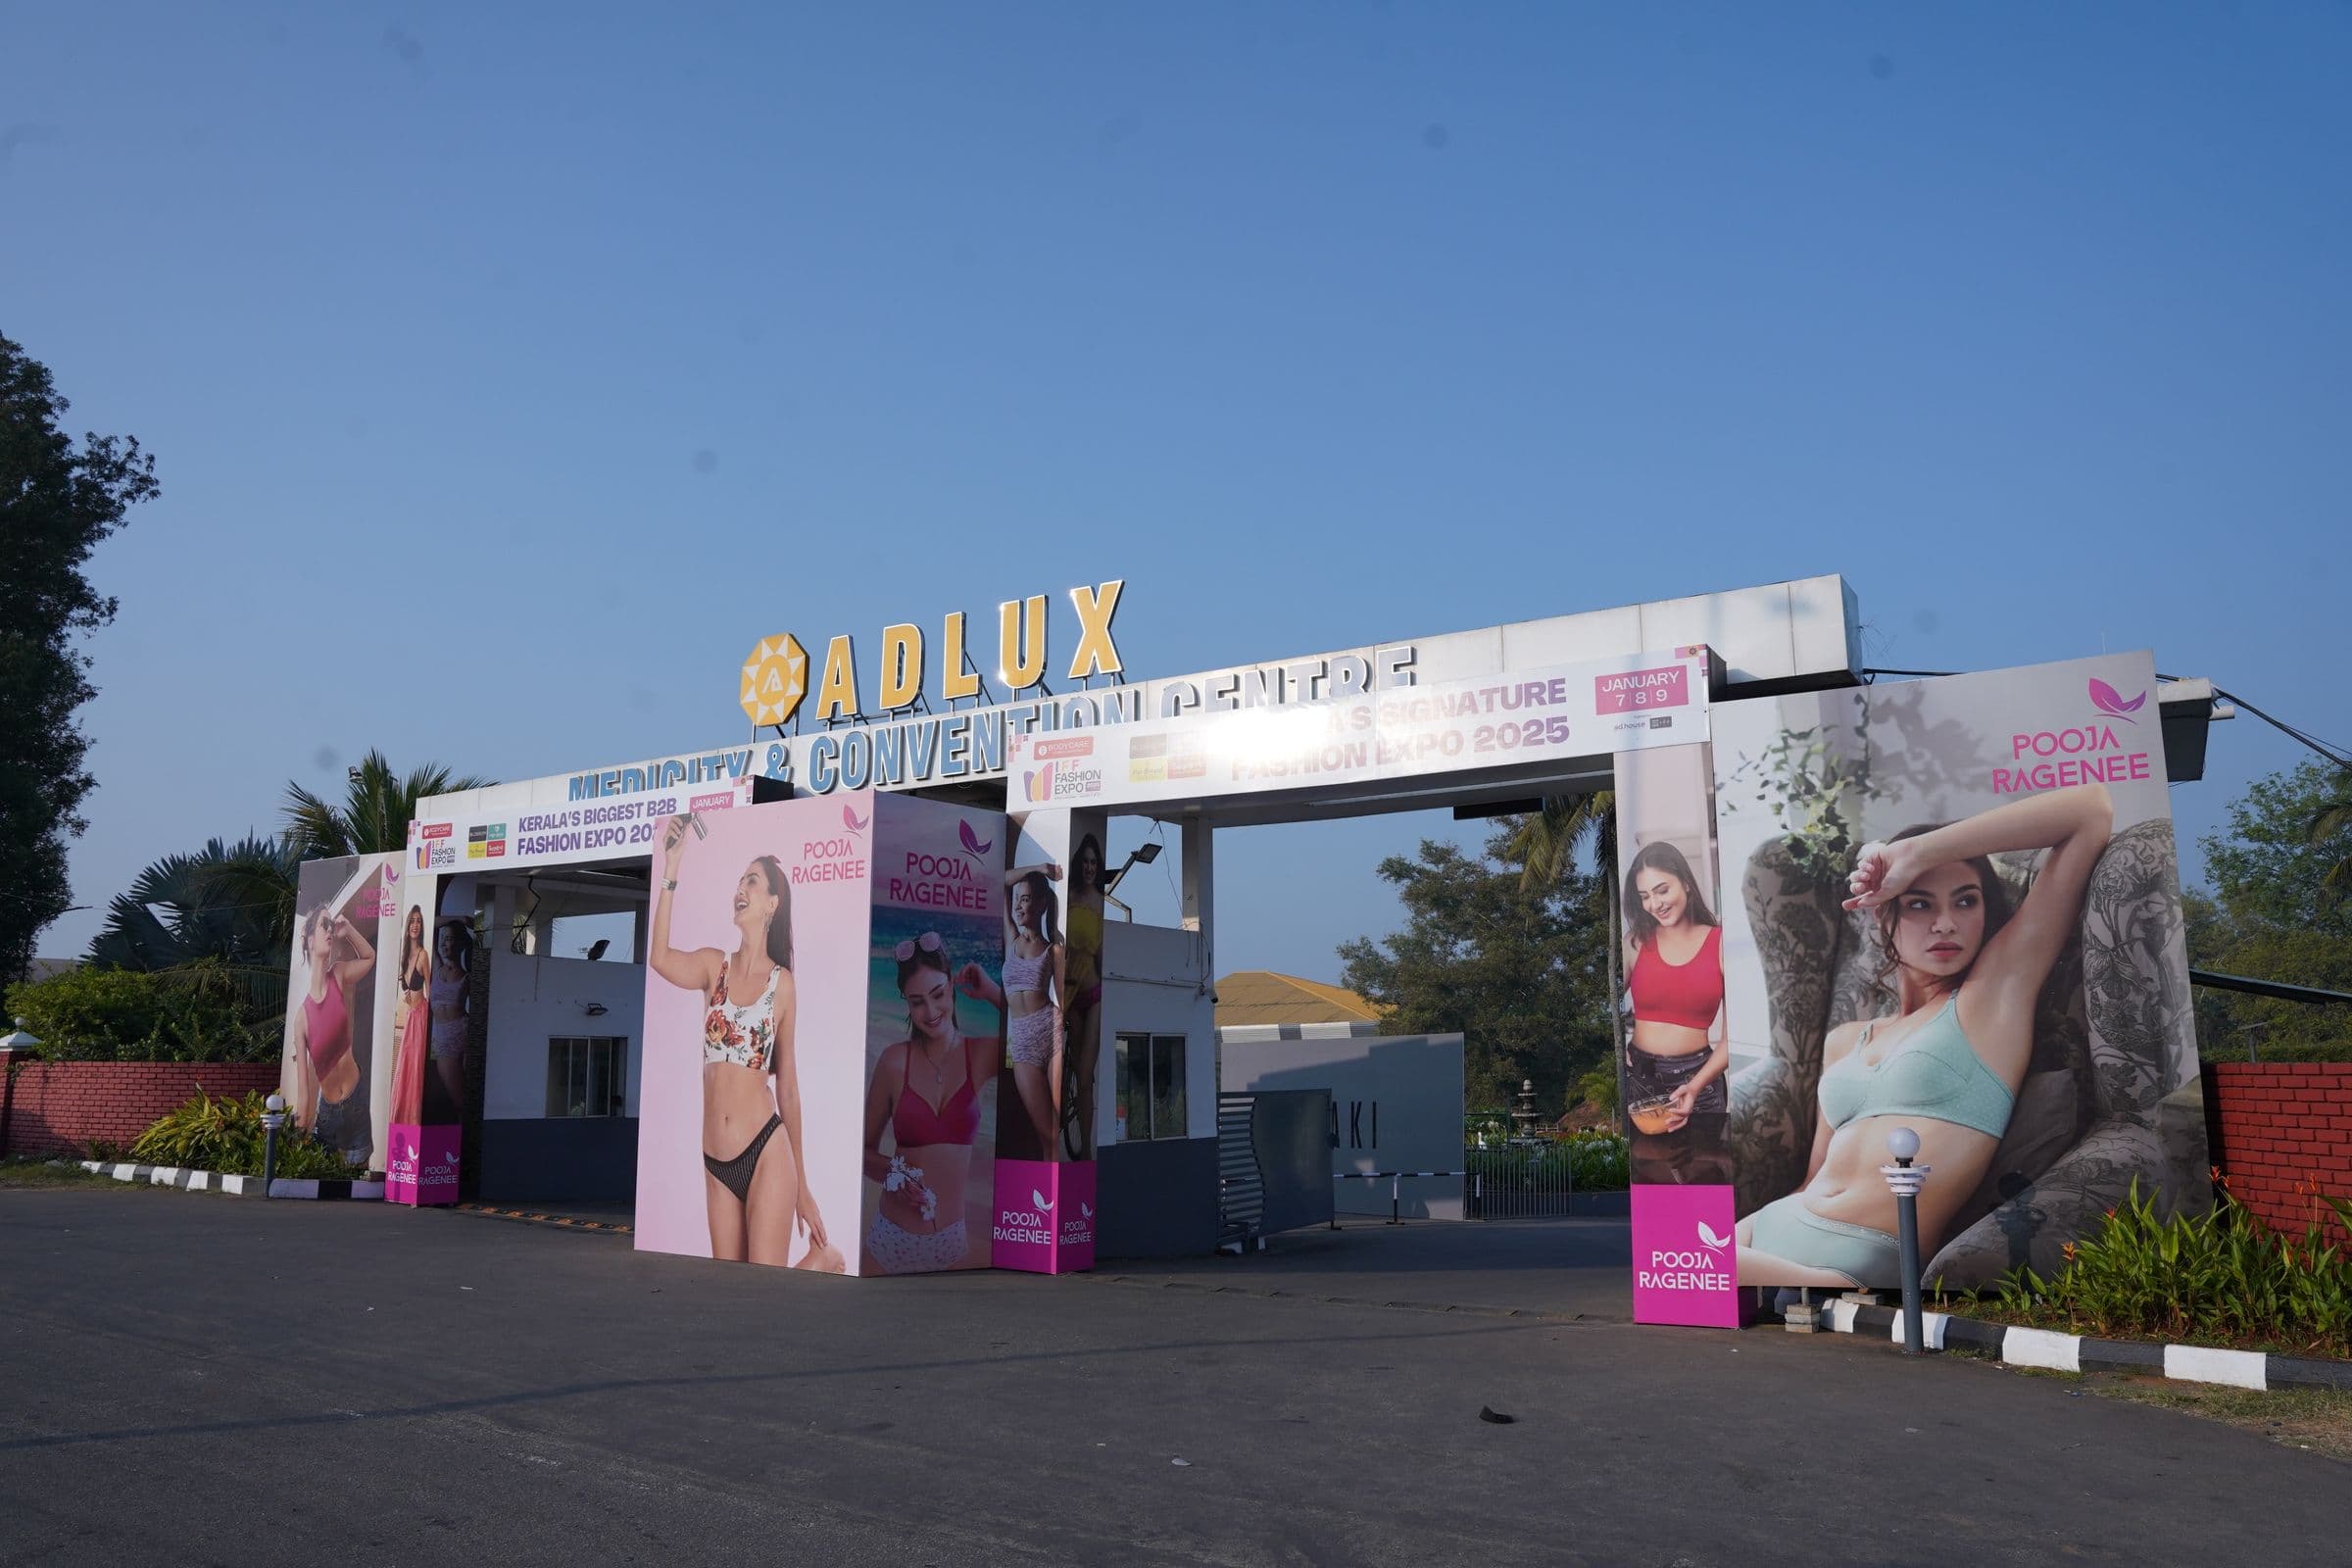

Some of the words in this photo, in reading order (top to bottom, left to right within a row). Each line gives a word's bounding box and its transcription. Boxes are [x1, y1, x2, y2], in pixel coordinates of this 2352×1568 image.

[815, 579, 1125, 720] ADLUX
[1160, 646, 1413, 718] CENTRE
[1602, 670, 1680, 692] JANUARY
[1380, 677, 1567, 724] SIGNATURE
[1616, 694, 1625, 707] 7
[1635, 691, 1646, 705] 8
[1656, 689, 1668, 702] 9
[1473, 715, 1570, 753] 2025
[2012, 725, 2120, 760] POOJA
[1048, 740, 1090, 752] BODYCARE
[1054, 769, 1102, 784] FASHION
[1992, 753, 2150, 795] RAGENEE
[1054, 782, 1084, 795] EXPO
[693, 795, 730, 808] JANUARY
[518, 809, 581, 833] KERALA'S
[583, 802, 644, 825] BIGGEST
[646, 797, 677, 816] B2B
[517, 834, 581, 856] FASHION
[584, 828, 626, 849] EXPO
[630, 824, 655, 843] 20
[804, 838, 853, 861] POOJA
[792, 859, 864, 884] RAGENEE
[906, 852, 972, 882] POOJA
[890, 878, 987, 909] RAGENEE
[392, 1160, 413, 1172] POOJA
[424, 1166, 452, 1175] POOJA
[388, 1171, 416, 1185] RAGENEE
[418, 1175, 458, 1186] RAGENEE
[1003, 1211, 1042, 1228] POOJA
[1064, 1220, 1087, 1232] POOJA
[993, 1226, 1052, 1245] RAGENEE
[1059, 1231, 1092, 1246] RAGENEE
[1652, 1250, 1714, 1269] POOJA
[1639, 1271, 1731, 1292] RAGENEE
